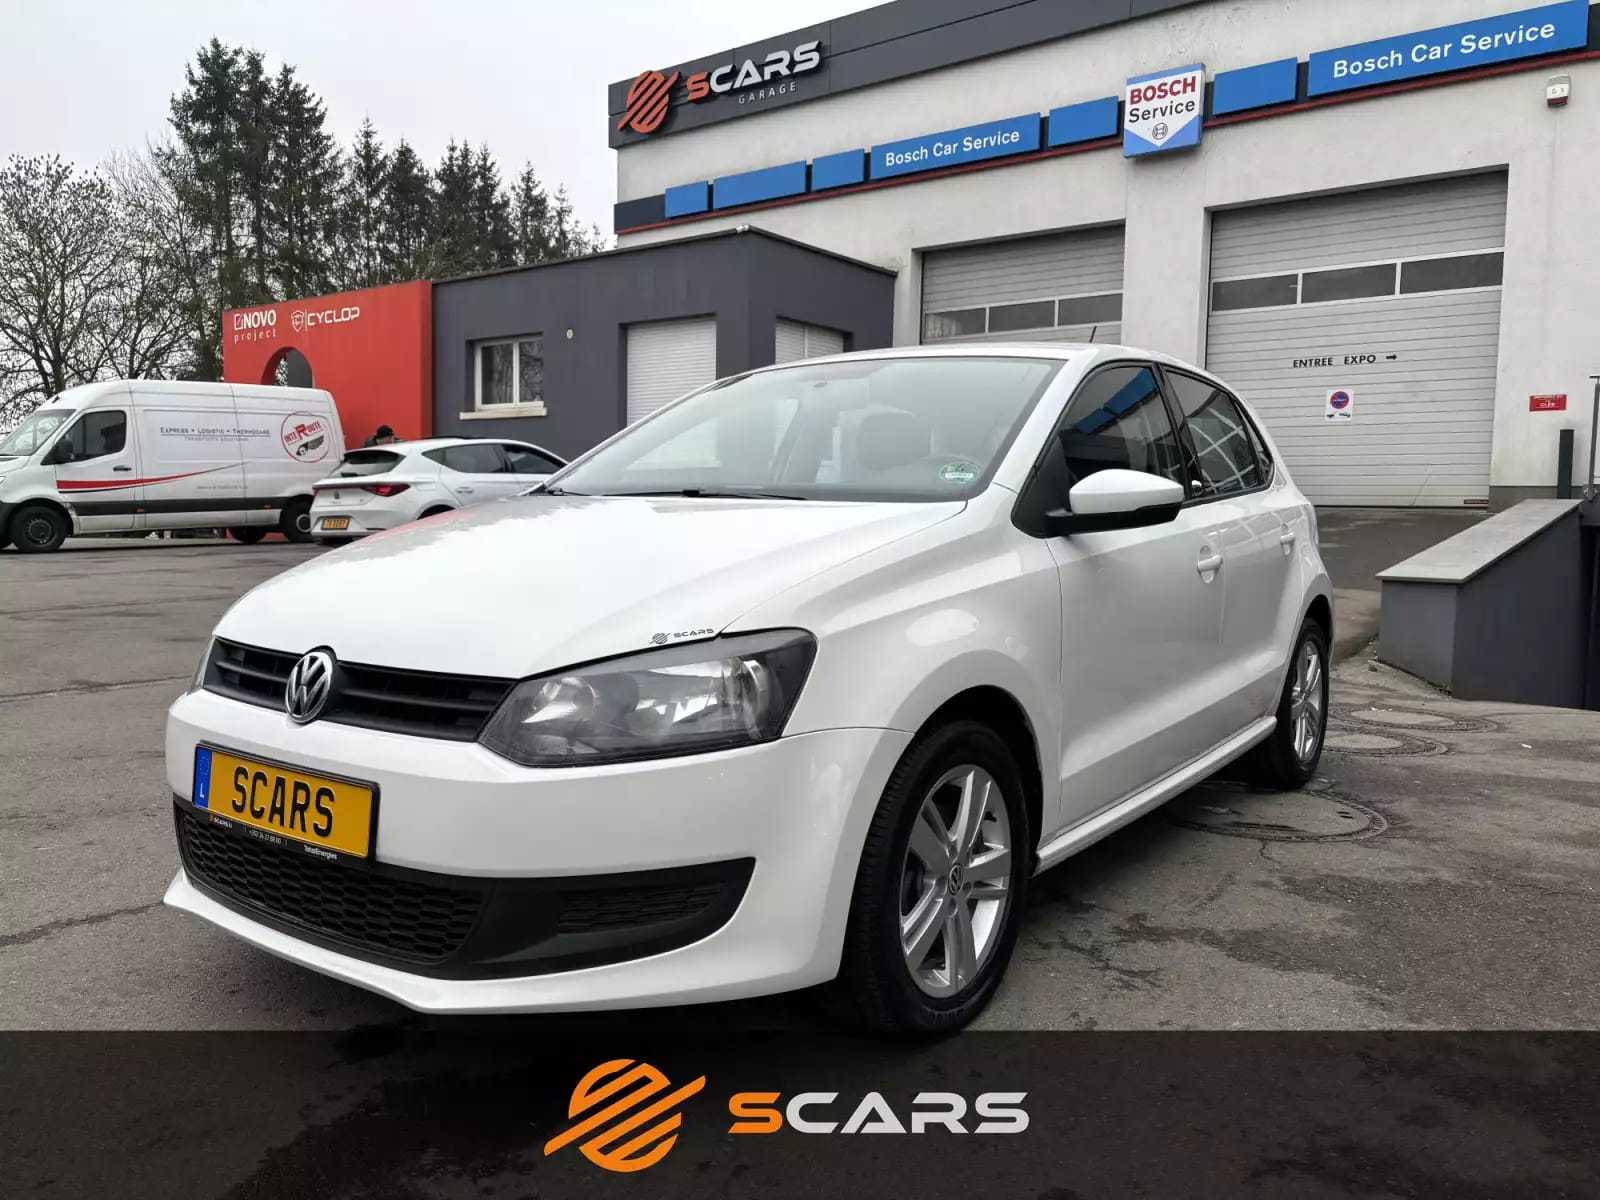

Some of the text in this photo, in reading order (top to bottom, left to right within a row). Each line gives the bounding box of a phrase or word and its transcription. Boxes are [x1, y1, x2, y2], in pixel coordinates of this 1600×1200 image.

[1333, 20, 1556, 79] Bosch Car Service
[686, 40, 821, 101] SCARS
[738, 81, 797, 104] GARAGE
[1129, 75, 1197, 105] BOSCH
[1128, 98, 1196, 124] Service
[885, 129, 1020, 167] Bosch Car Service
[307, 306, 360, 326] CYCLOP
[234, 328, 276, 344] project
[1293, 354, 1377, 368] ENTREE EXPO
[674, 629, 714, 638] SCARS
[231, 765, 336, 838] SCARS
